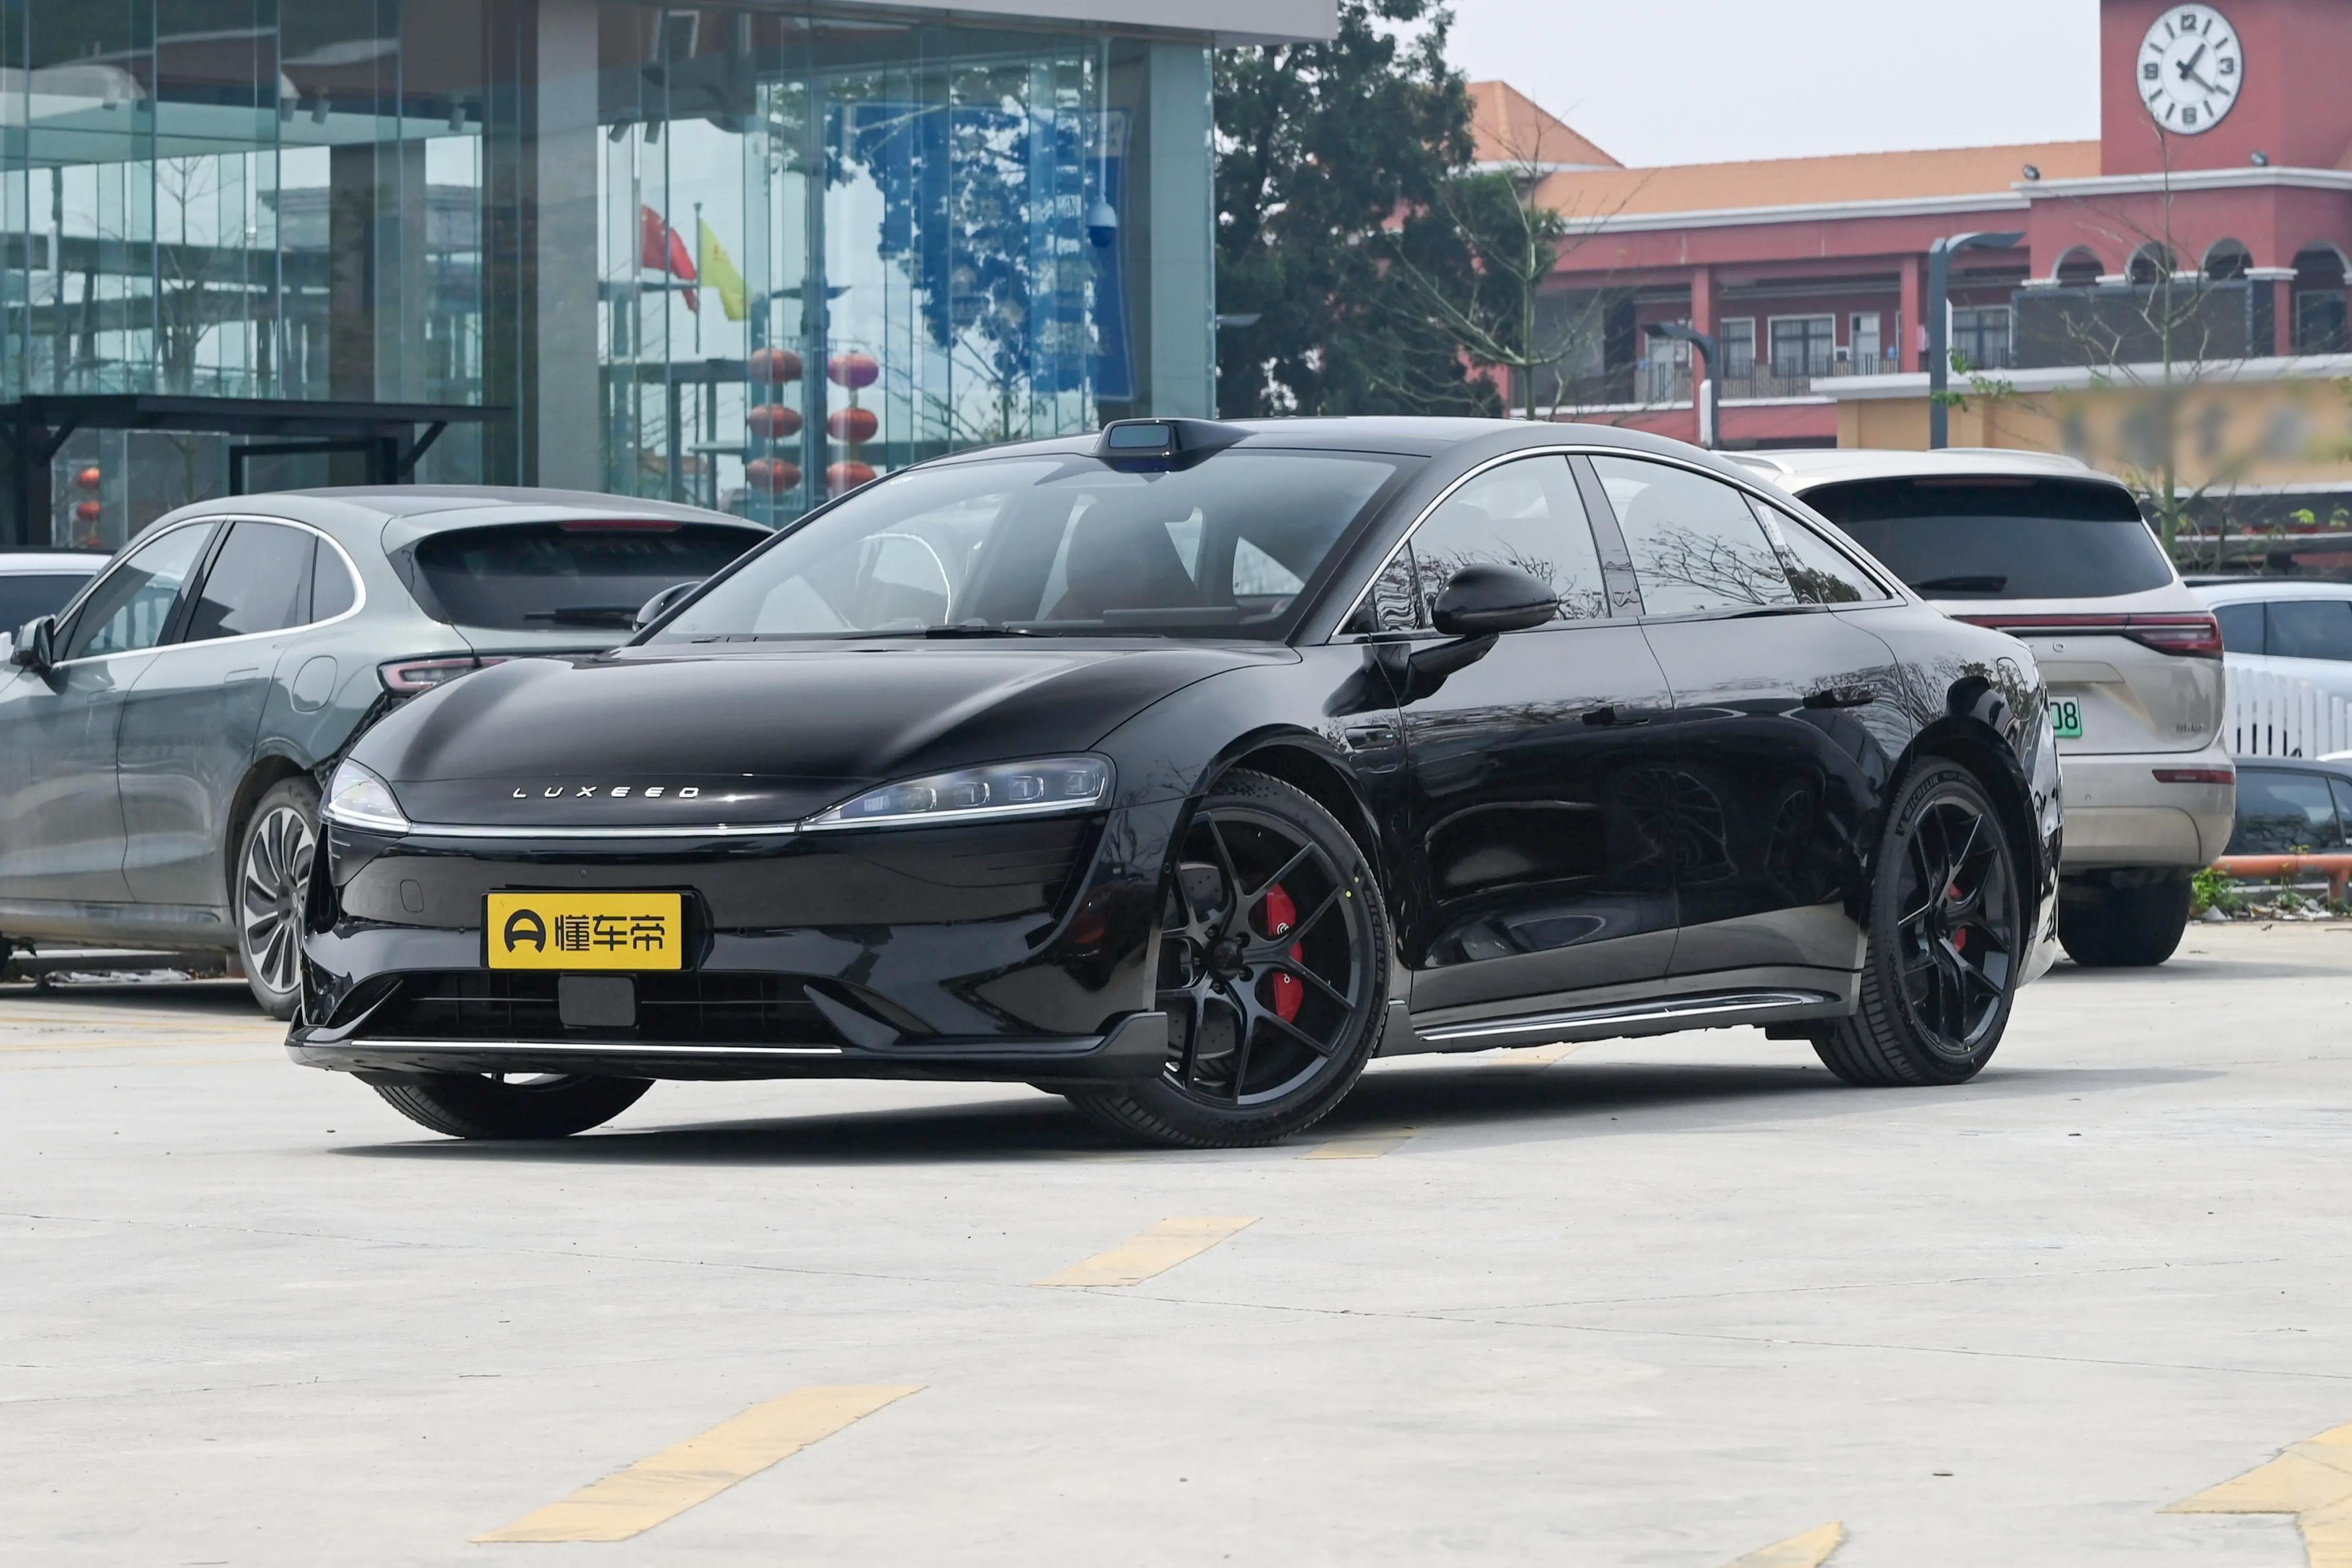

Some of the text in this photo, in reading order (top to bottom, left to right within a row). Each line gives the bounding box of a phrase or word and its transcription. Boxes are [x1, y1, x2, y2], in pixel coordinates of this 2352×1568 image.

[2181, 13, 2196, 31] 12
[2220, 58, 2234, 75] 3
[513, 786, 699, 799] LUXEED
[1904, 774, 1939, 819] MICHELIN
[555, 914, 665, 951] 懂车帝
[1363, 889, 1385, 984] MICHELIN
